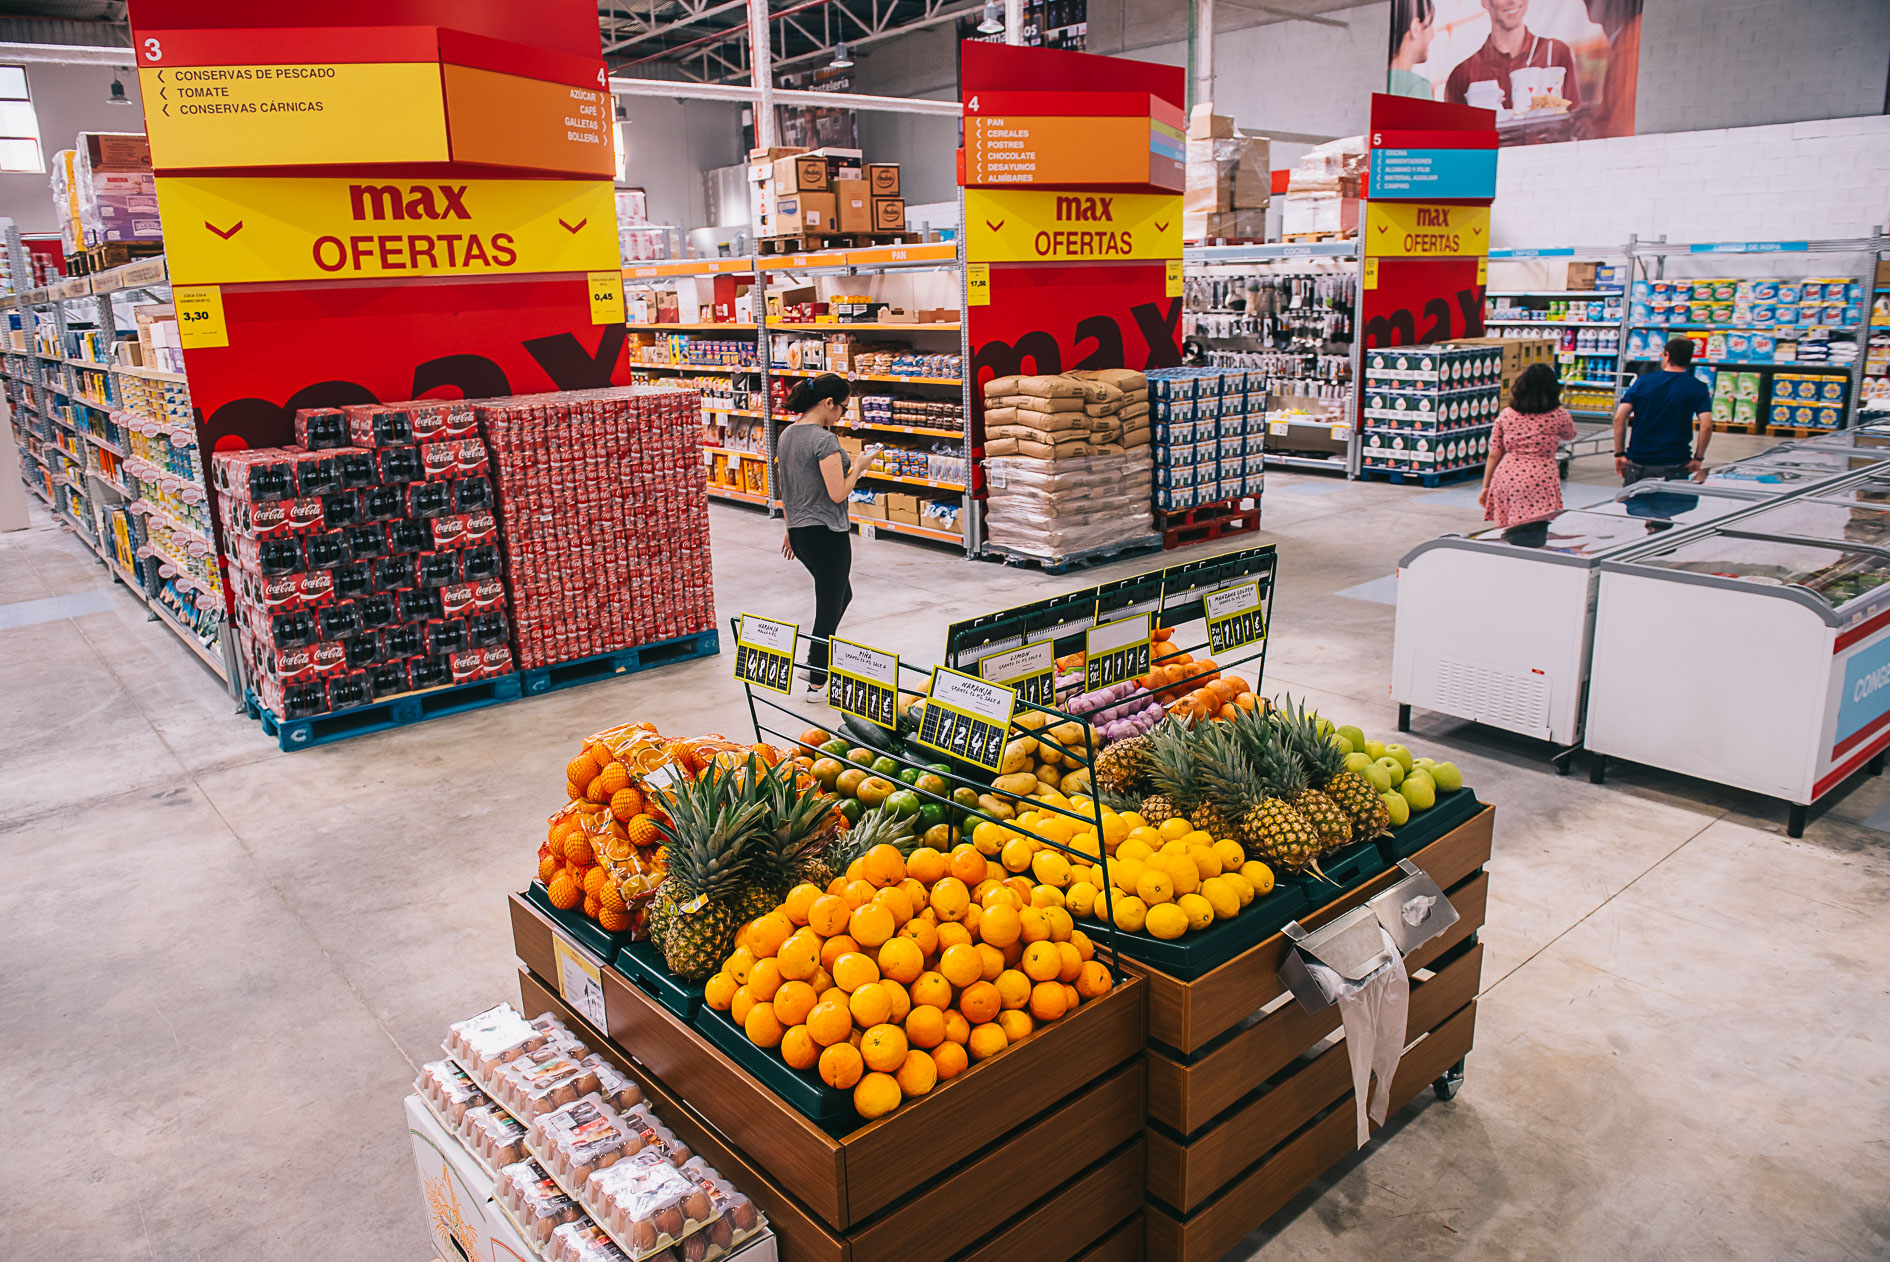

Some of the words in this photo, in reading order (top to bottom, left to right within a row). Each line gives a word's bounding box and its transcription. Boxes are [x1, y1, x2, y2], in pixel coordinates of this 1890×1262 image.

[144, 38, 163, 62] 3
[175, 69, 252, 81] CONSERVAS
[256, 69, 273, 79] DE
[276, 67, 335, 79] PESCADO
[597, 67, 606, 87] 4
[177, 87, 229, 98] TOMATE
[569, 88, 597, 102] AZÚCAR
[180, 103, 257, 115] CONSERVAS
[260, 100, 324, 113] CÁRNICAS
[968, 95, 980, 112] 4
[579, 104, 597, 116] CAFÉ
[564, 116, 599, 130] GALLETAS
[987, 118, 1004, 126] PAN
[567, 131, 600, 144] BOLLERÍA
[987, 129, 1029, 138] CEREALES
[1373, 133, 1382, 145] 5
[987, 141, 1024, 149] POSTRES
[987, 152, 1036, 160] CHOCOLATE
[987, 163, 1036, 171] DESAYUNOS
[987, 172, 1033, 182] ALMÍBARES
[349, 184, 473, 221] max
[1056, 195, 1113, 221] max
[1416, 208, 1450, 227] max
[1035, 230, 1133, 256] OFERTAS
[1404, 233, 1460, 253] OFERTAS
[312, 233, 518, 272] OFERTAS
[891, 250, 907, 260] PAN
[1283, 247, 1312, 256] COCINA
[708, 263, 719, 272] PAN
[794, 258, 806, 266] PAN
[594, 293, 613, 302] 0,45
[183, 311, 209, 322] 3,30
[758, 623, 779, 633] NARANJA
[859, 651, 872, 660] PIÑA
[961, 682, 993, 697] NARANJA
